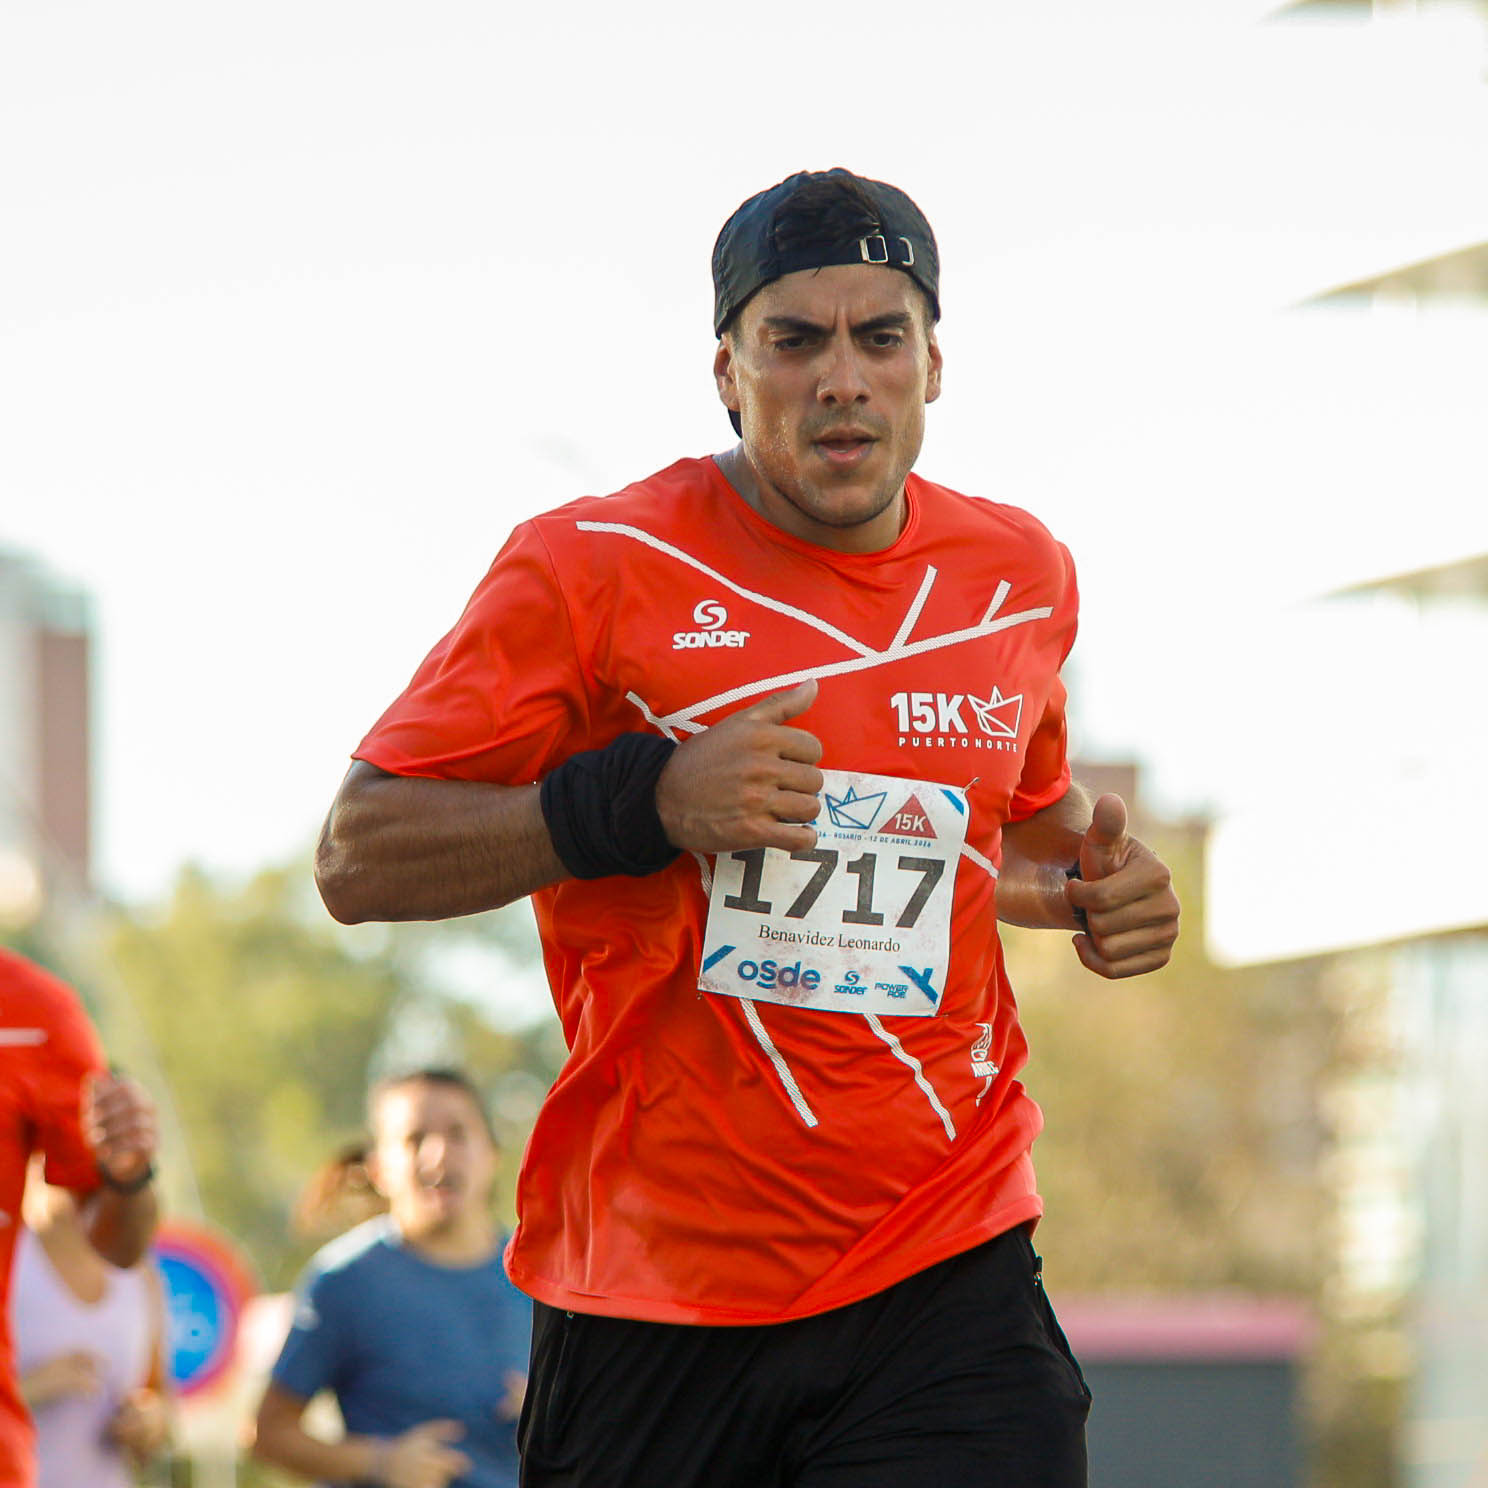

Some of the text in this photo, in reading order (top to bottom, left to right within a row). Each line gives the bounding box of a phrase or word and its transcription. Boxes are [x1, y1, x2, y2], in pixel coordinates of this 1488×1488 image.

[890, 692, 969, 733] 15K
[898, 737, 1017, 753] PUERTO NORTE
[894, 812, 928, 832] 15K
[891, 837, 912, 846] ABRIL
[723, 847, 946, 929] 1717
[758, 924, 901, 953] Benavidez Leonardo
[737, 959, 821, 991] osde
